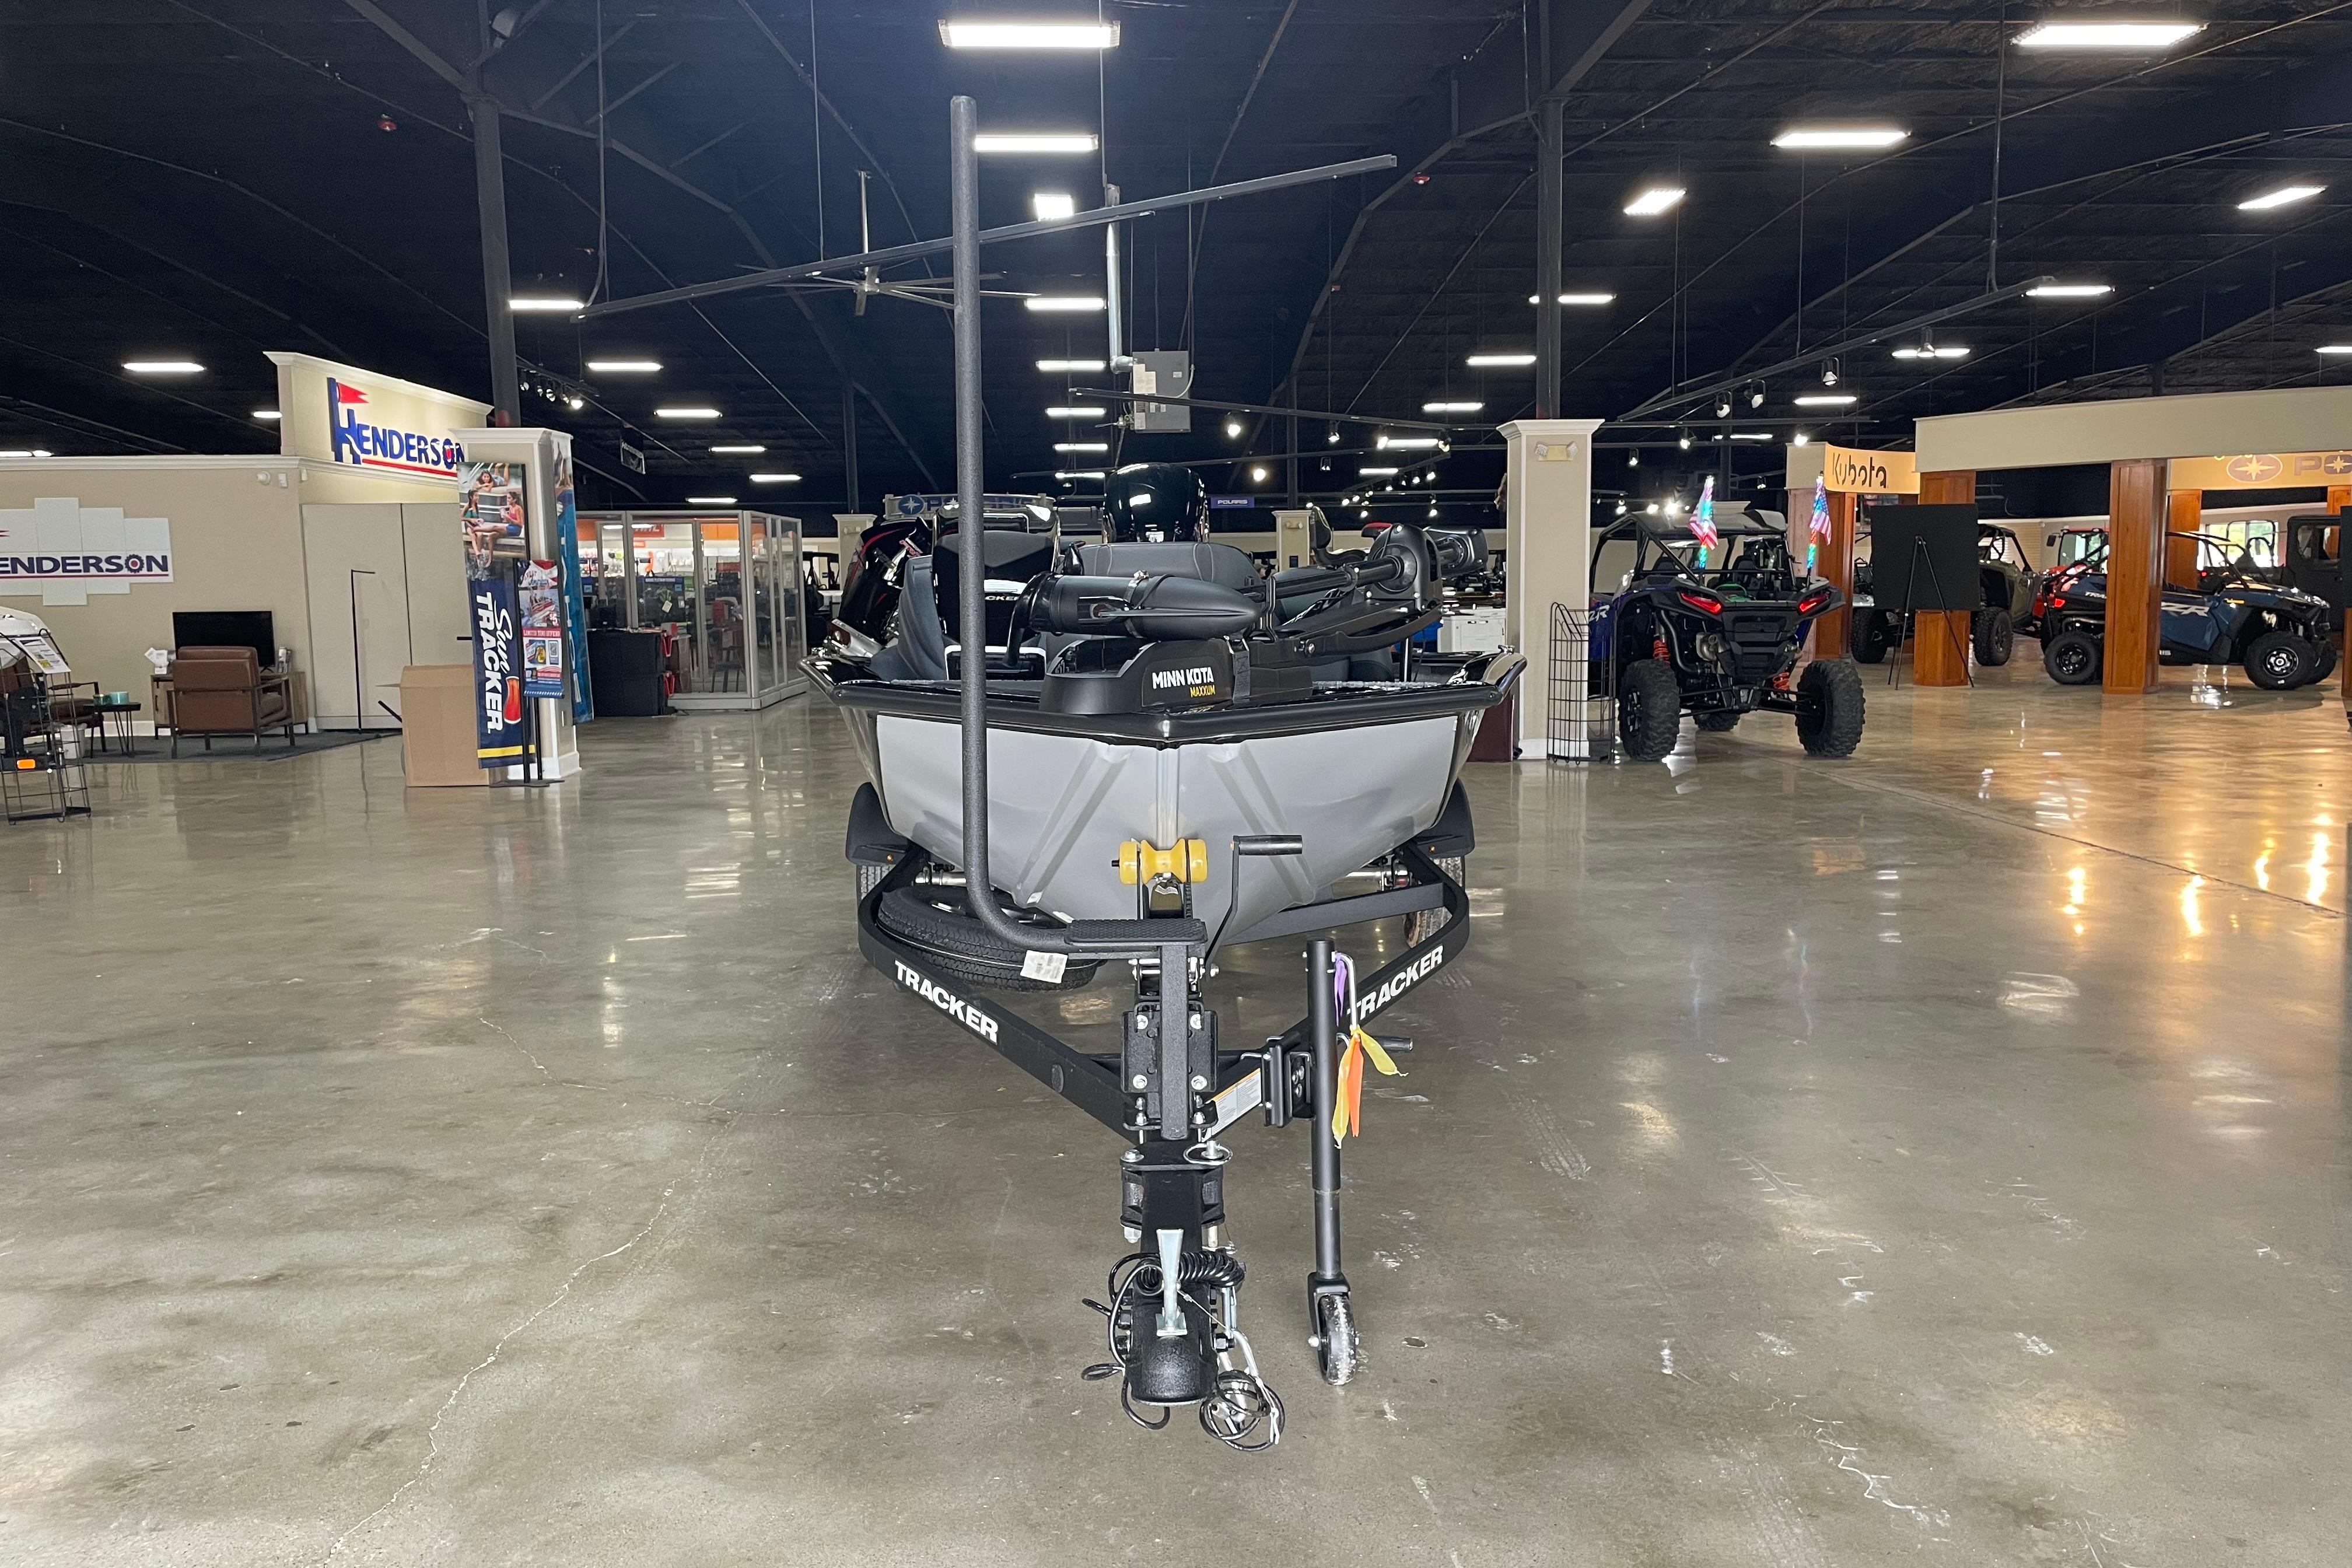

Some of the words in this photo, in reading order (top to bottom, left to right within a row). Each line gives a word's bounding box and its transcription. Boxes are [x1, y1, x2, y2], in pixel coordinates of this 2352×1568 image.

[1832, 452, 1887, 489] Kubota
[477, 592, 503, 731] TRACKER
[494, 600, 513, 674] Sun
[1152, 669, 1186, 690] MINN
[1186, 667, 1214, 685] KOTA
[1189, 684, 1216, 698] MAXXUM
[895, 960, 999, 1044] TRACKER
